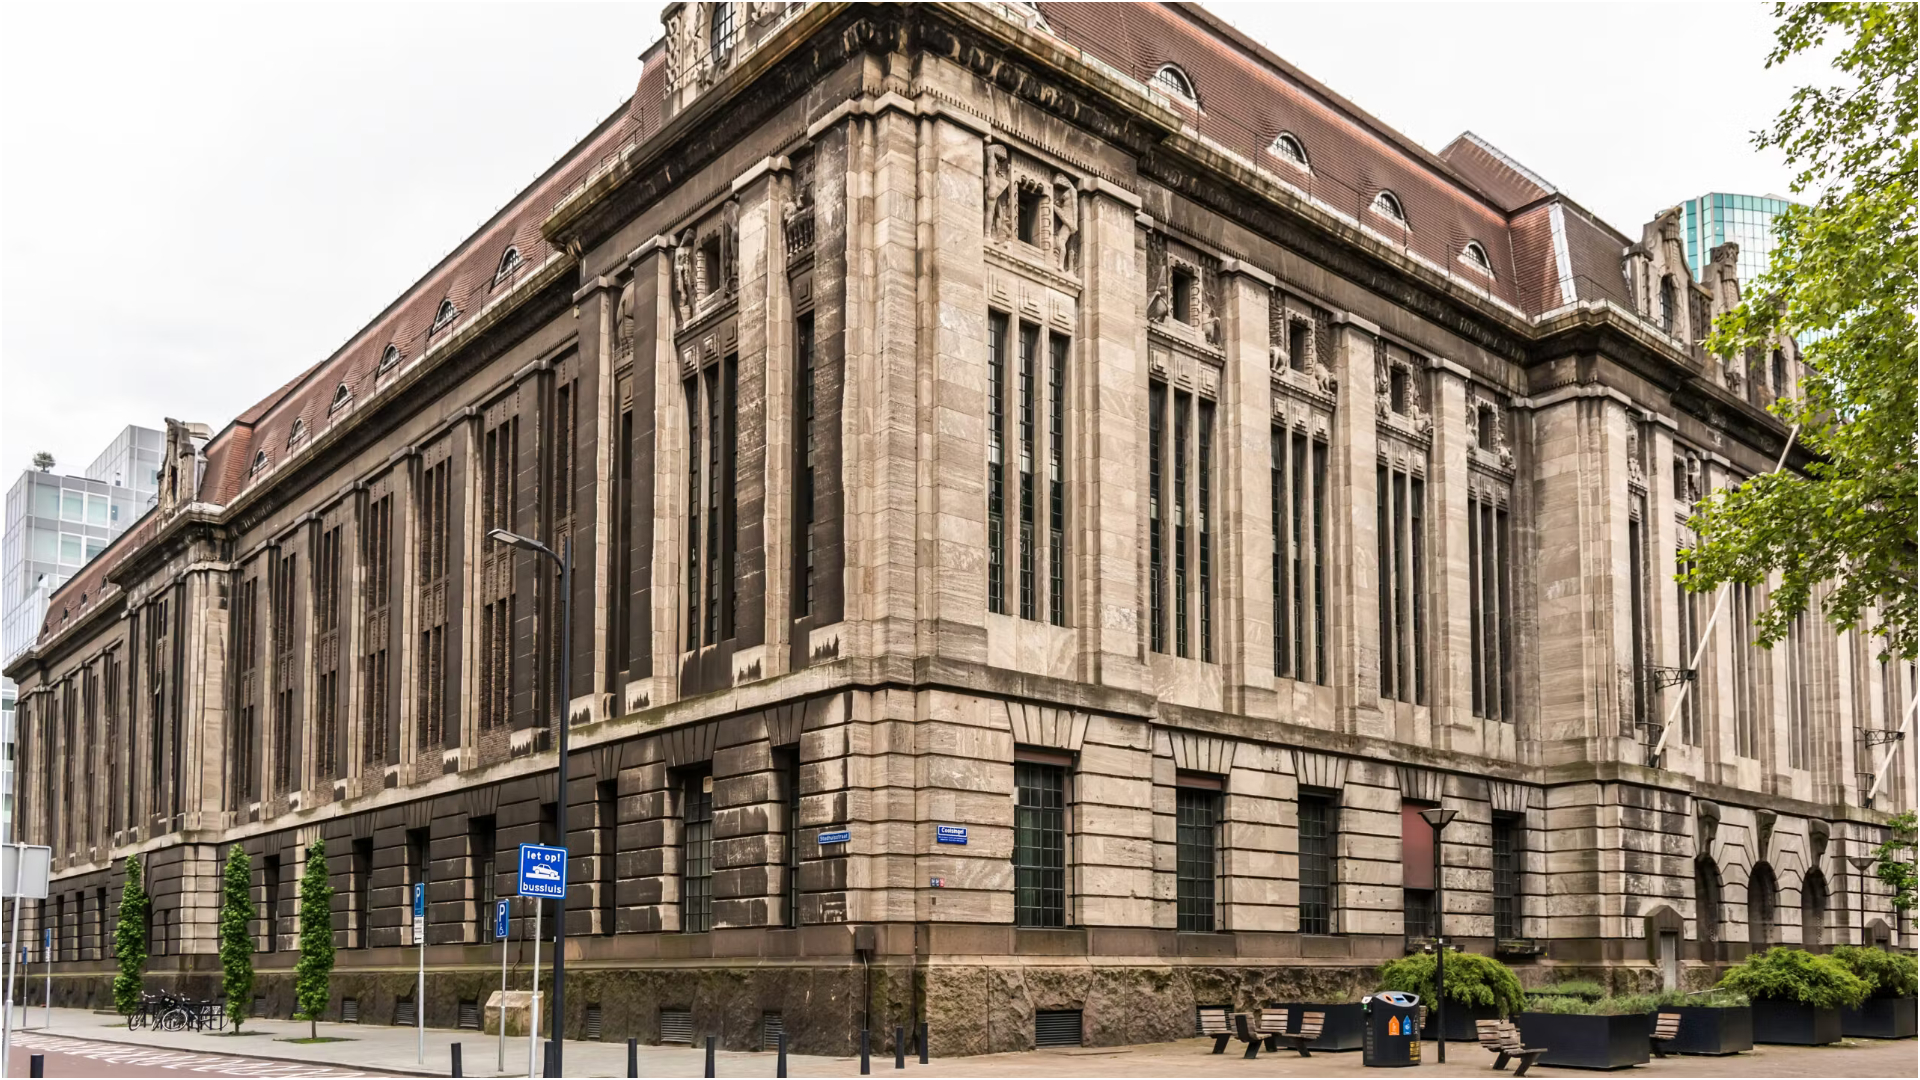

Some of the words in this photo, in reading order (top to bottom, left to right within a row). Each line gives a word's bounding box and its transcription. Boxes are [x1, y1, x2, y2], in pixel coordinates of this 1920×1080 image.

[941, 827, 964, 835] Coolsingel
[527, 850, 541, 860] let
[544, 853, 561, 863] op!
[522, 882, 562, 894] bussluis
[415, 887, 421, 903] P
[499, 904, 506, 922] P
